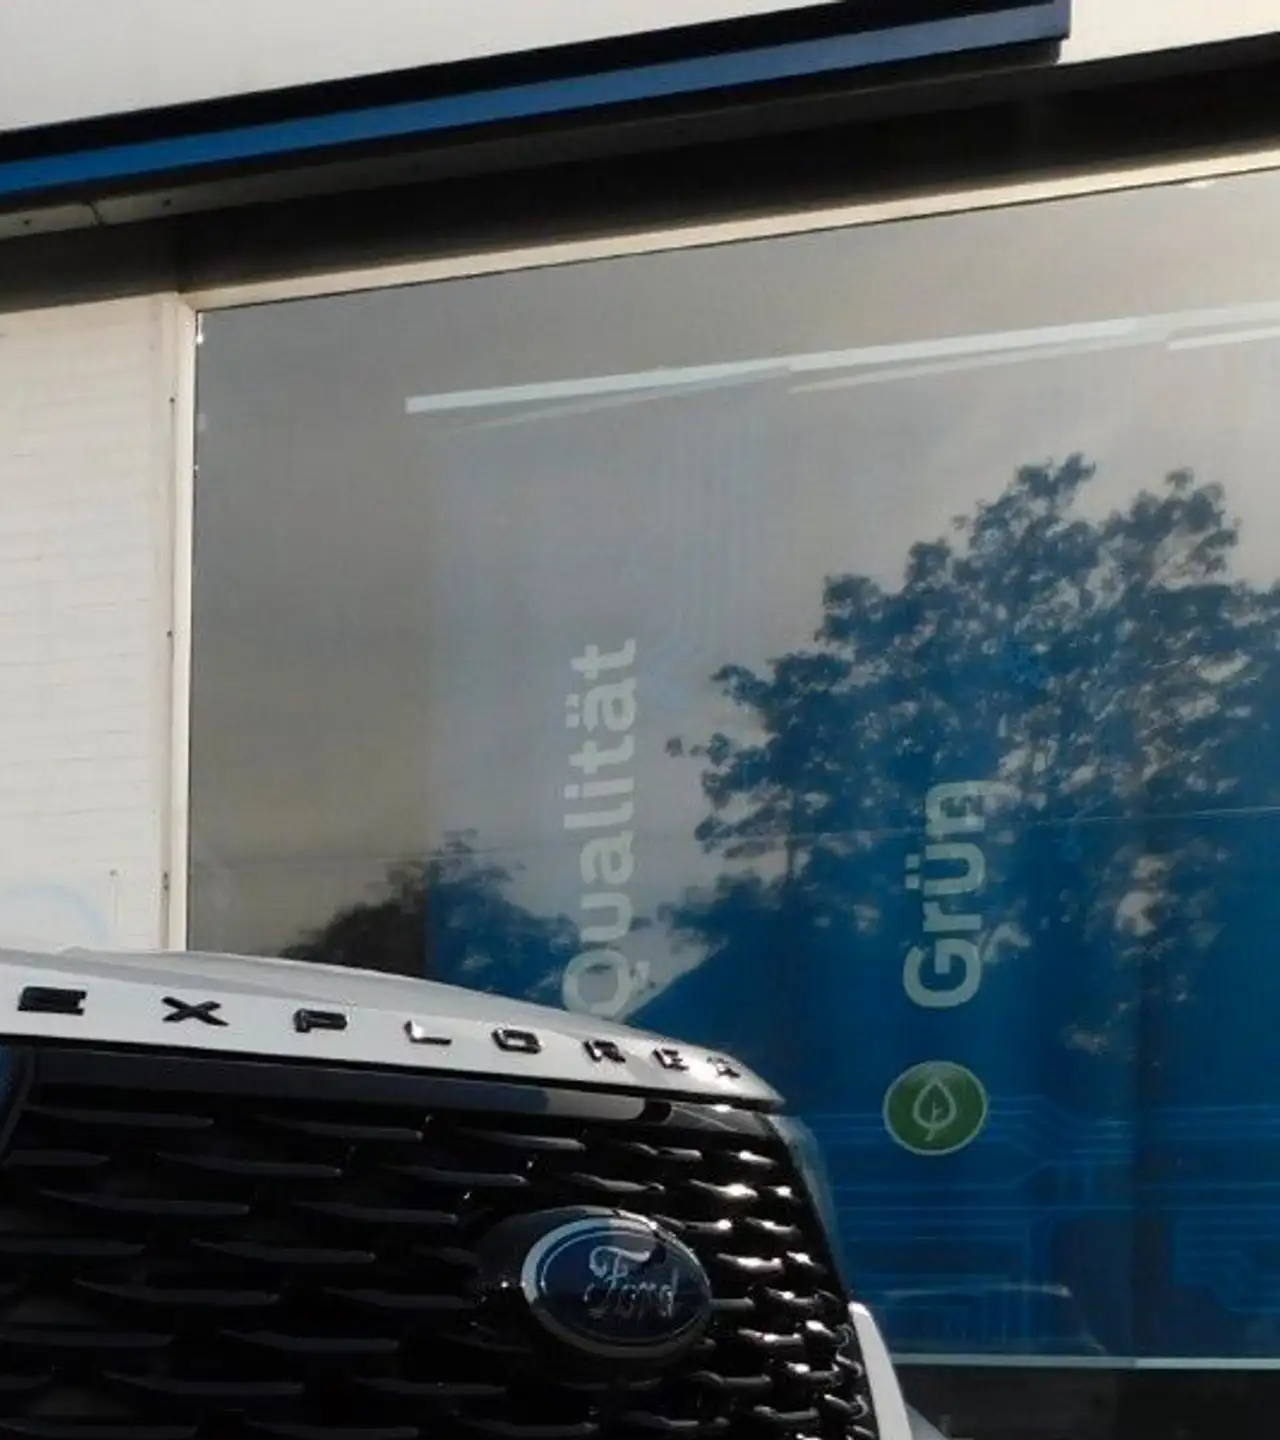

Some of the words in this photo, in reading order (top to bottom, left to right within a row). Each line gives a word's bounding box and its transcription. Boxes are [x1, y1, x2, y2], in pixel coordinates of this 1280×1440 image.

[561, 638, 649, 1019] Qualität
[903, 780, 987, 1008] Grün
[16, 985, 742, 1080] EXPLORER
[582, 1244, 680, 1322] Ford
